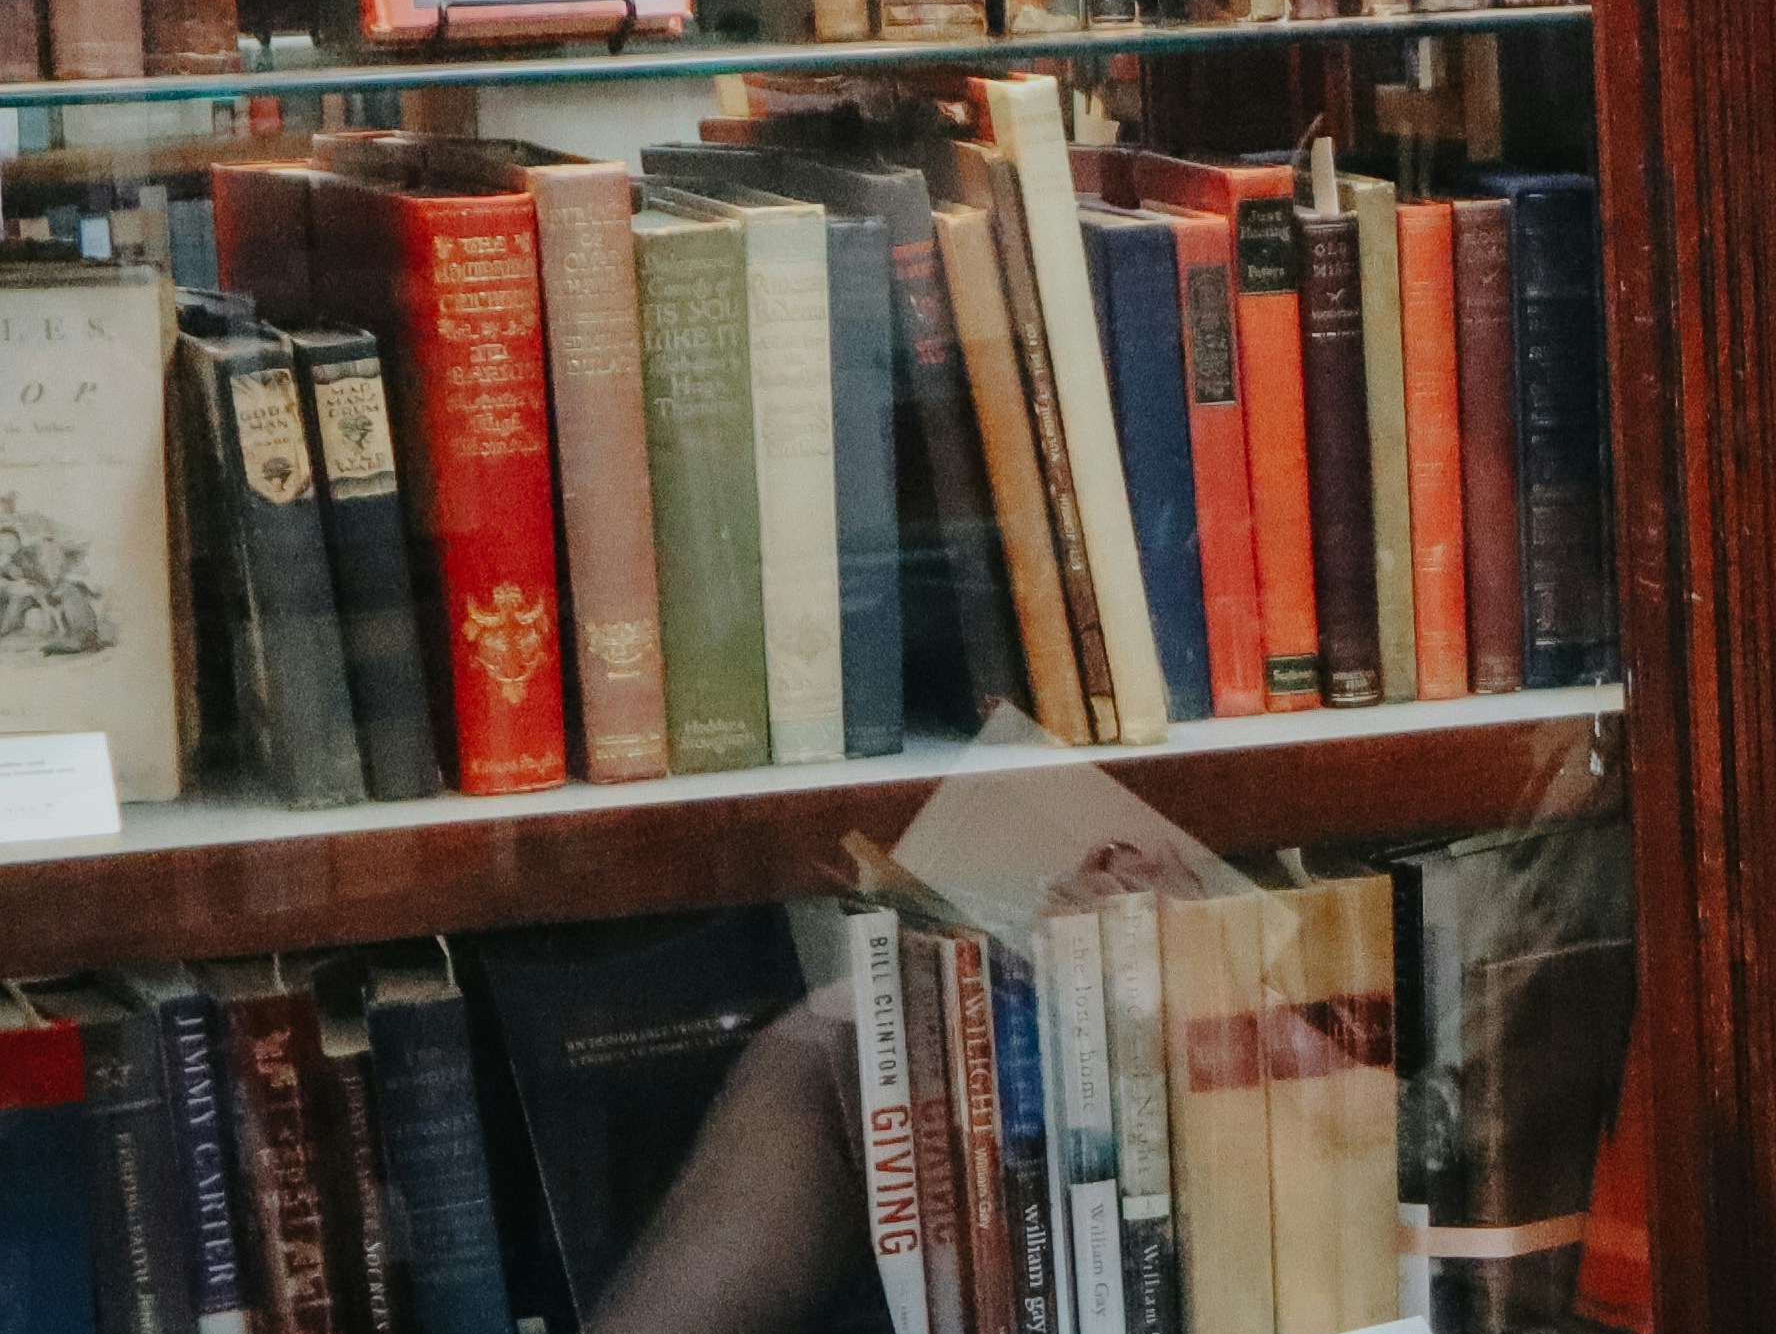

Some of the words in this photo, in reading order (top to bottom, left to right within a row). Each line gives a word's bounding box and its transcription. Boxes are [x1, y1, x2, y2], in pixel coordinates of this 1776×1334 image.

[868, 936, 892, 983] BILL
[873, 993, 899, 1089] CLINTON
[1071, 984, 1098, 1040] long
[173, 1013, 213, 1129] JIMMY
[962, 970, 995, 1141] TWILIGHT
[1078, 1049, 1103, 1114] home
[192, 1142, 236, 1285] CARTER
[870, 1103, 920, 1258] GIVING
[1023, 1202, 1049, 1289] william
[1088, 1202, 1109, 1275] William
[1090, 1281, 1113, 1319] Gay
[1142, 1243, 1163, 1325] William
